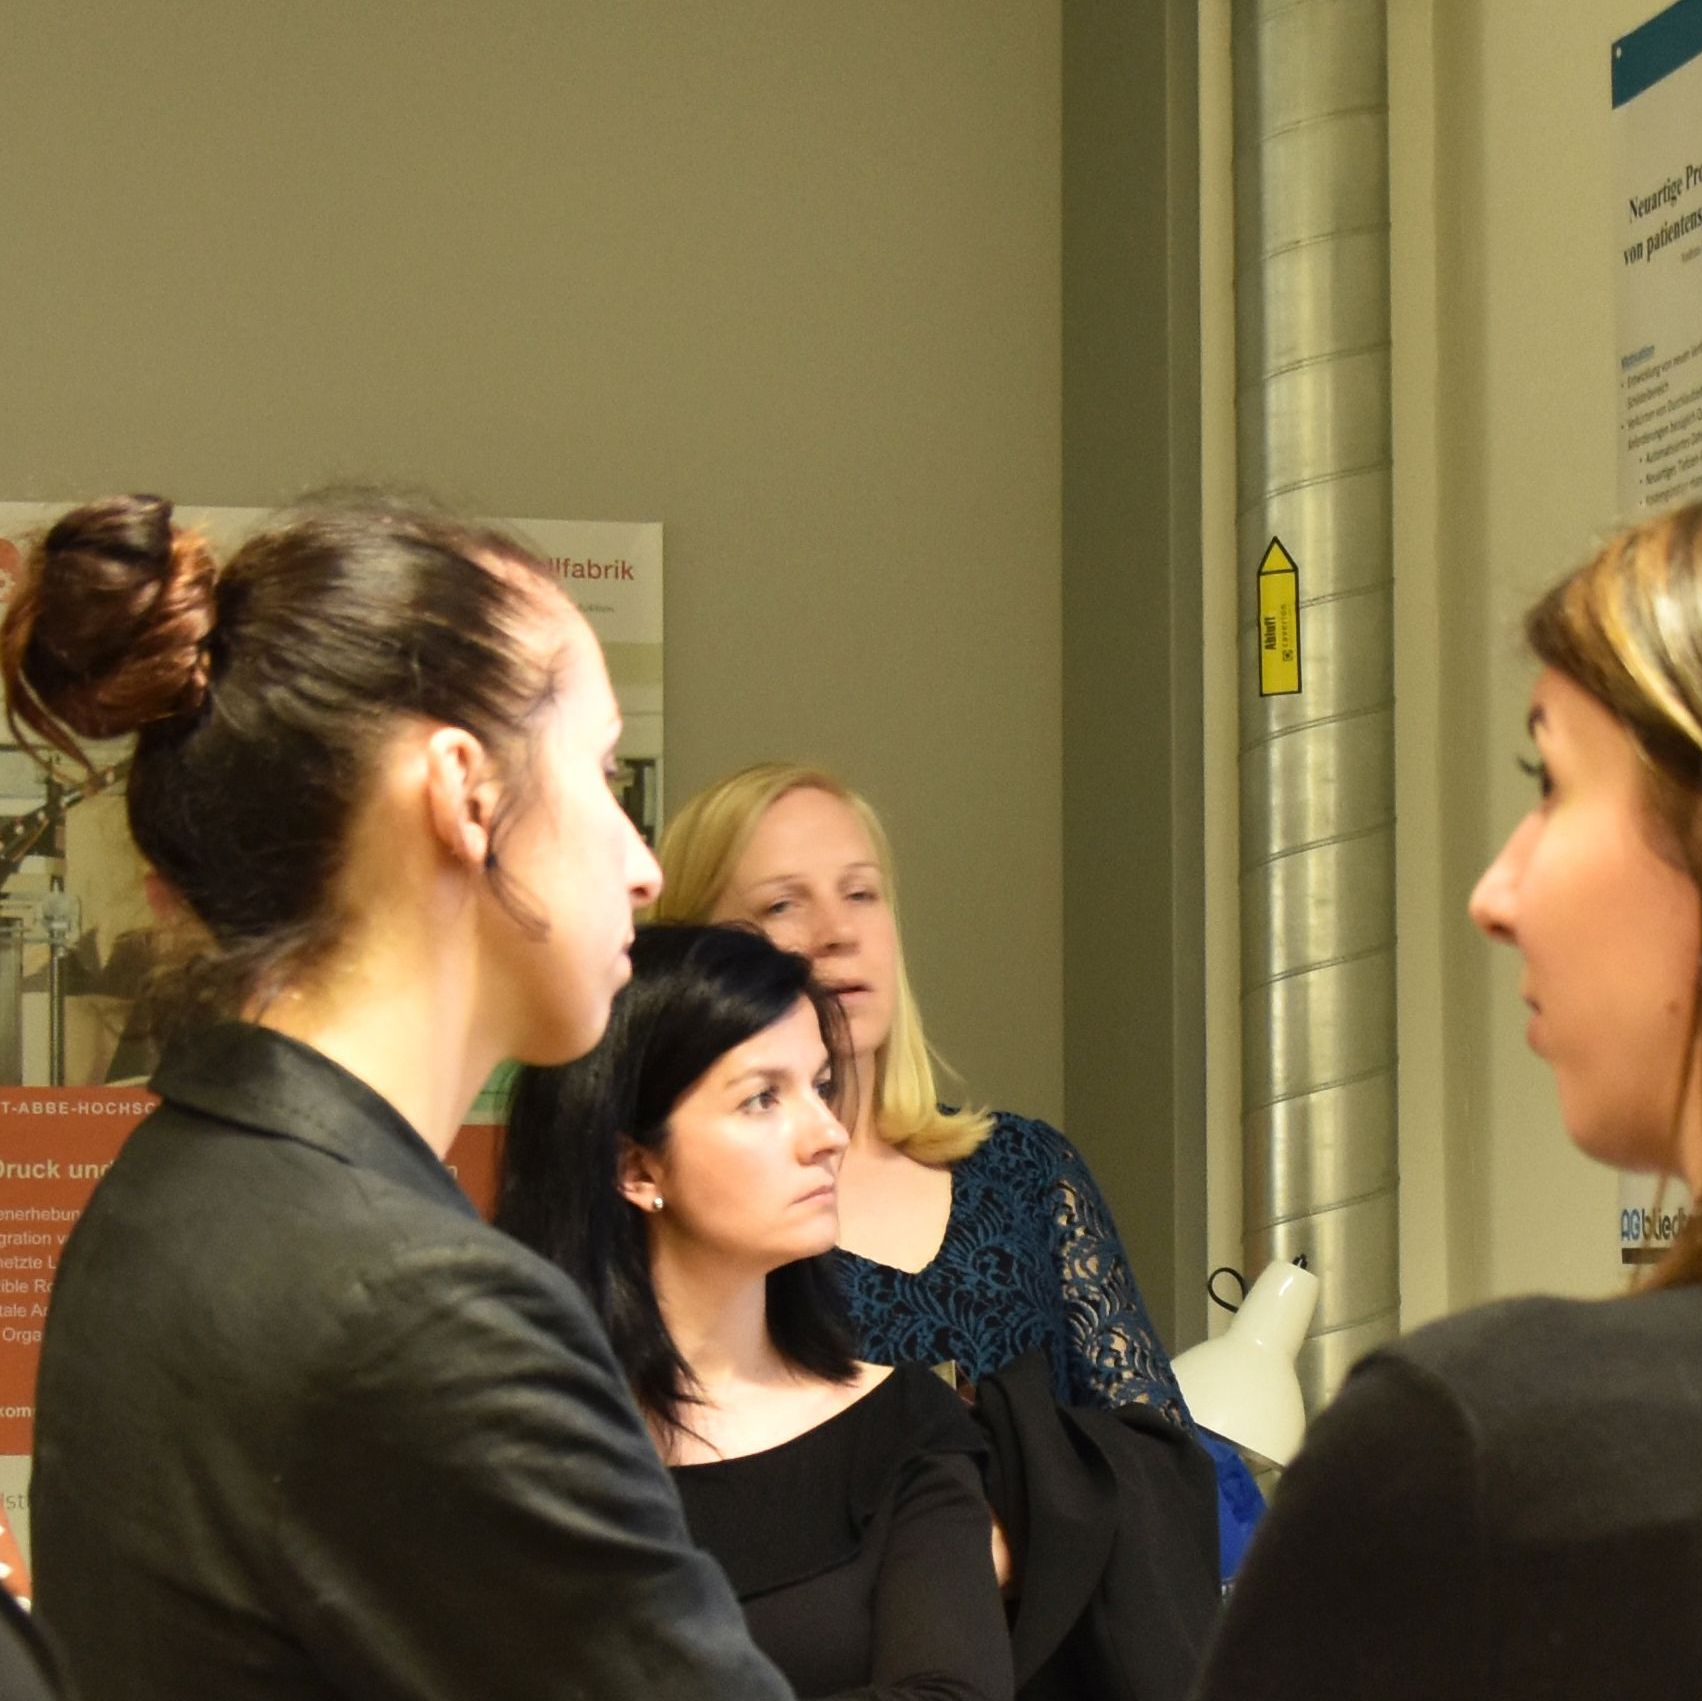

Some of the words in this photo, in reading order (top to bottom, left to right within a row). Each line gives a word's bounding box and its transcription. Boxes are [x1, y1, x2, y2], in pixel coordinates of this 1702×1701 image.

[1629, 174, 1684, 224] Neuartige
[1623, 239, 1644, 267] von
[1263, 616, 1277, 651] Abluft
